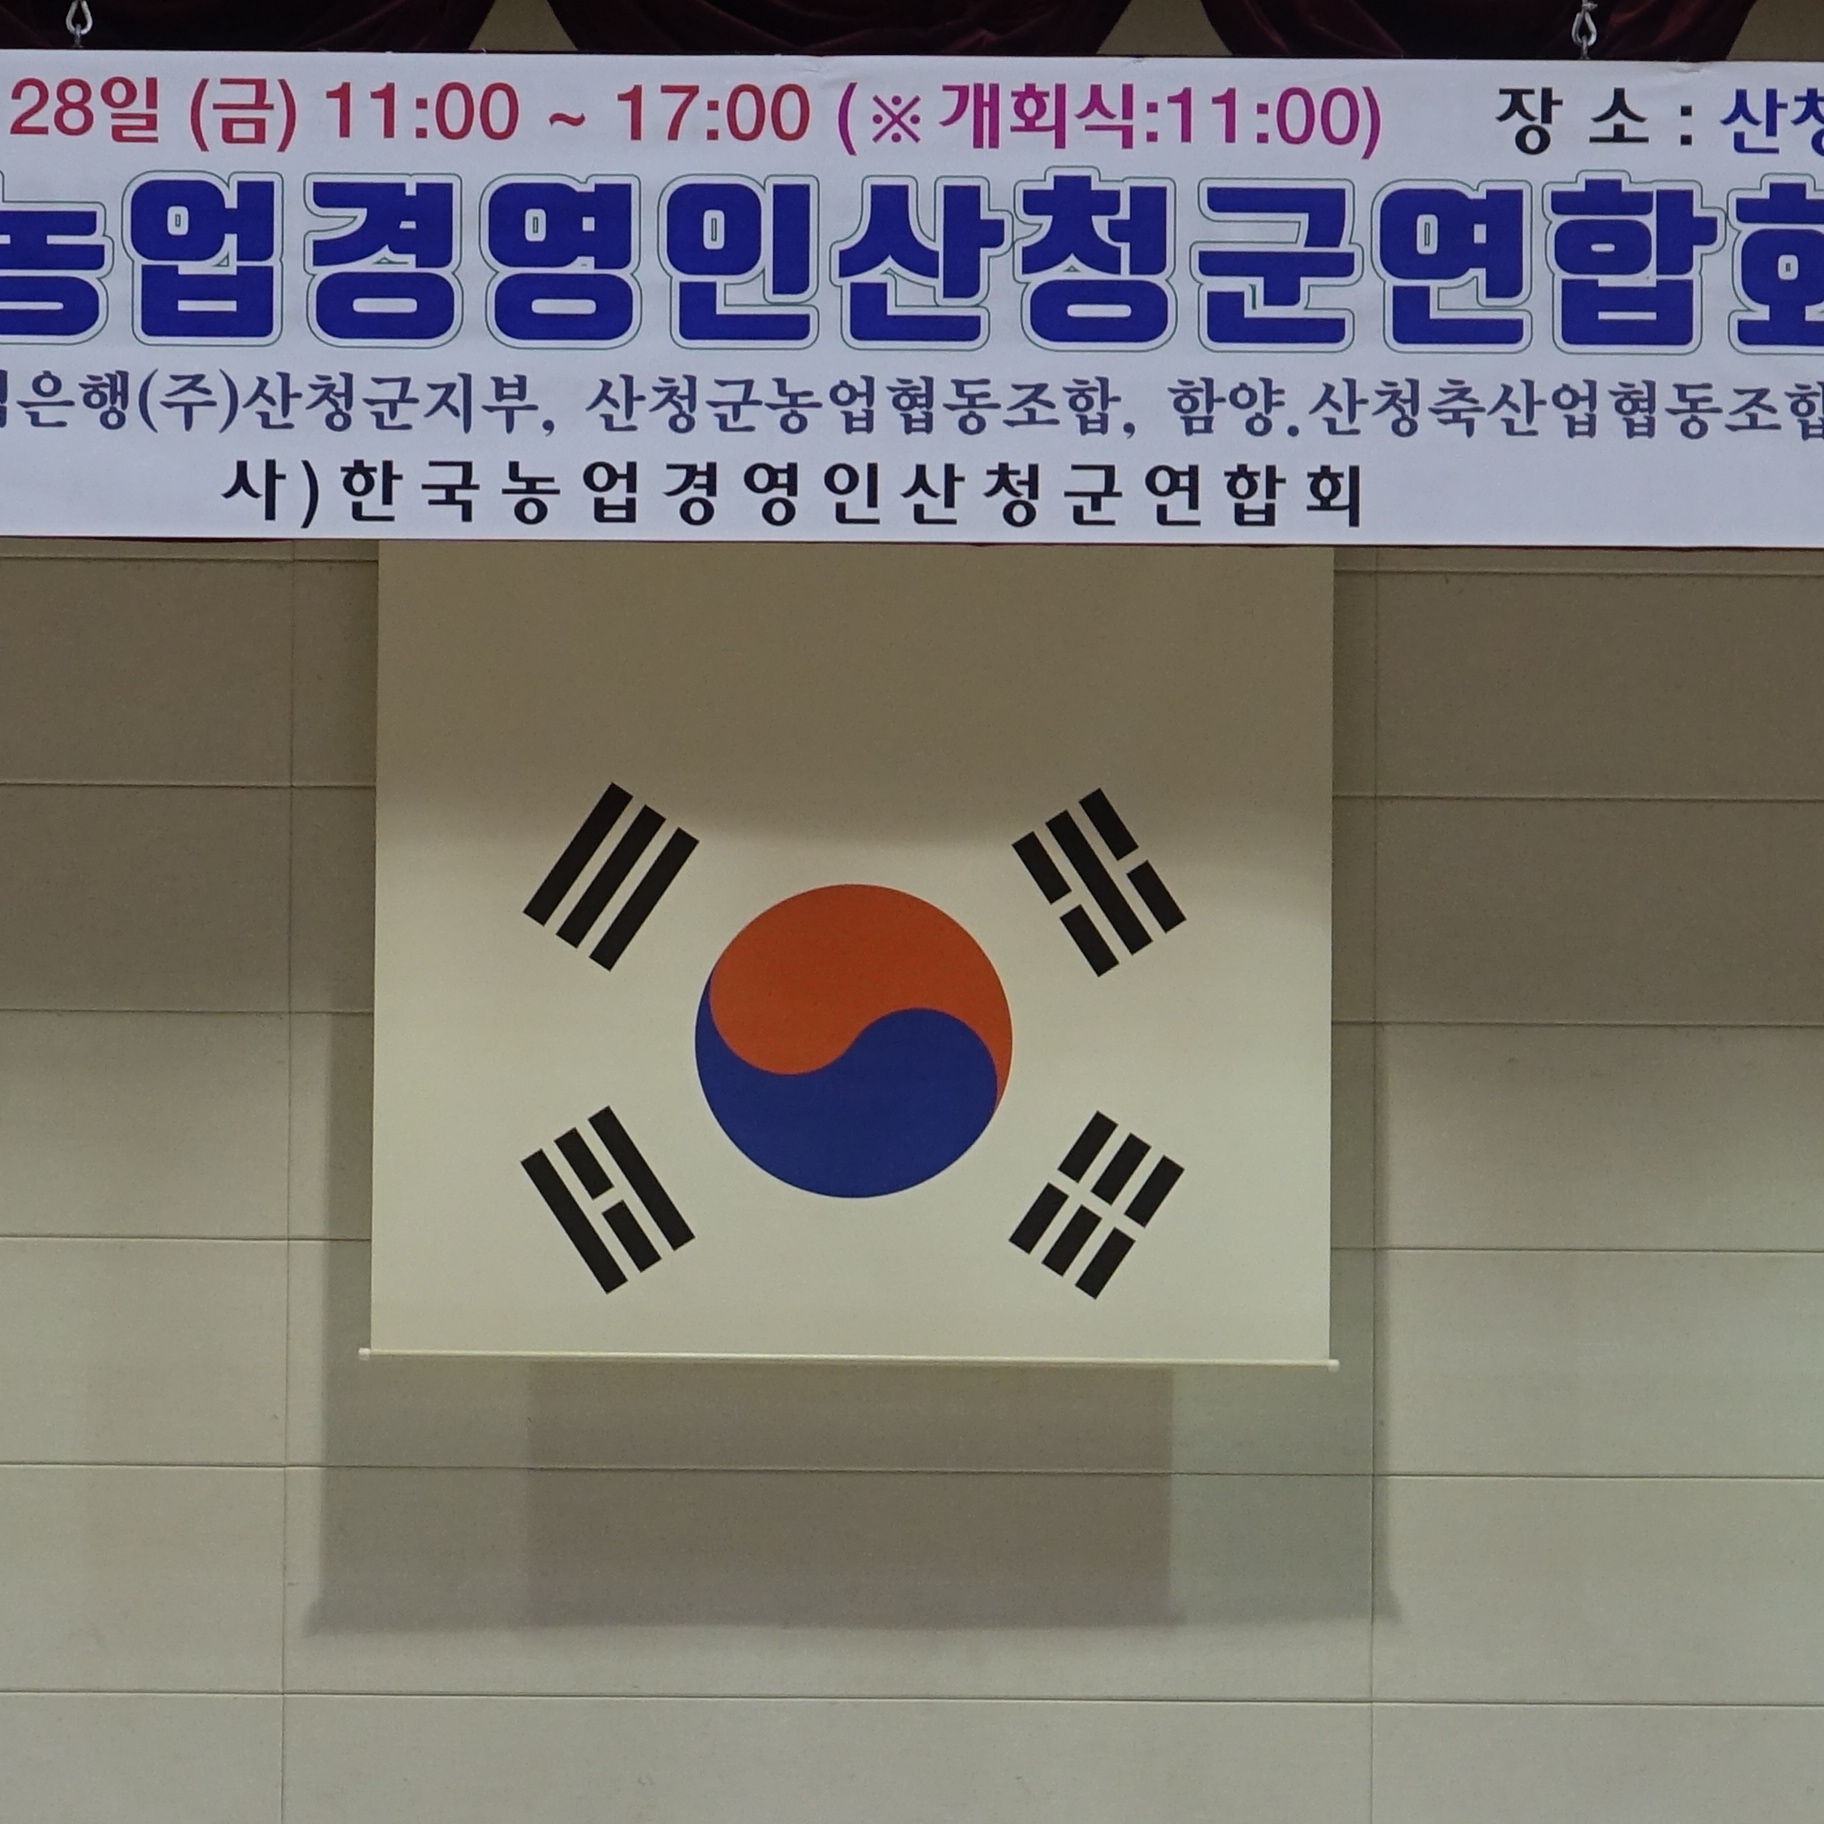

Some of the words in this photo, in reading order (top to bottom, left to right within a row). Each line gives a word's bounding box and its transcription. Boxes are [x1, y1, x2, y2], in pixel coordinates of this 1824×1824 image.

[10, 76, 161, 145] 28일
[188, 80, 297, 154] (금)
[326, 83, 518, 143] 11:00
[617, 84, 811, 143] 17:00
[586, 370, 1136, 441] 산청군농업협동조합,
